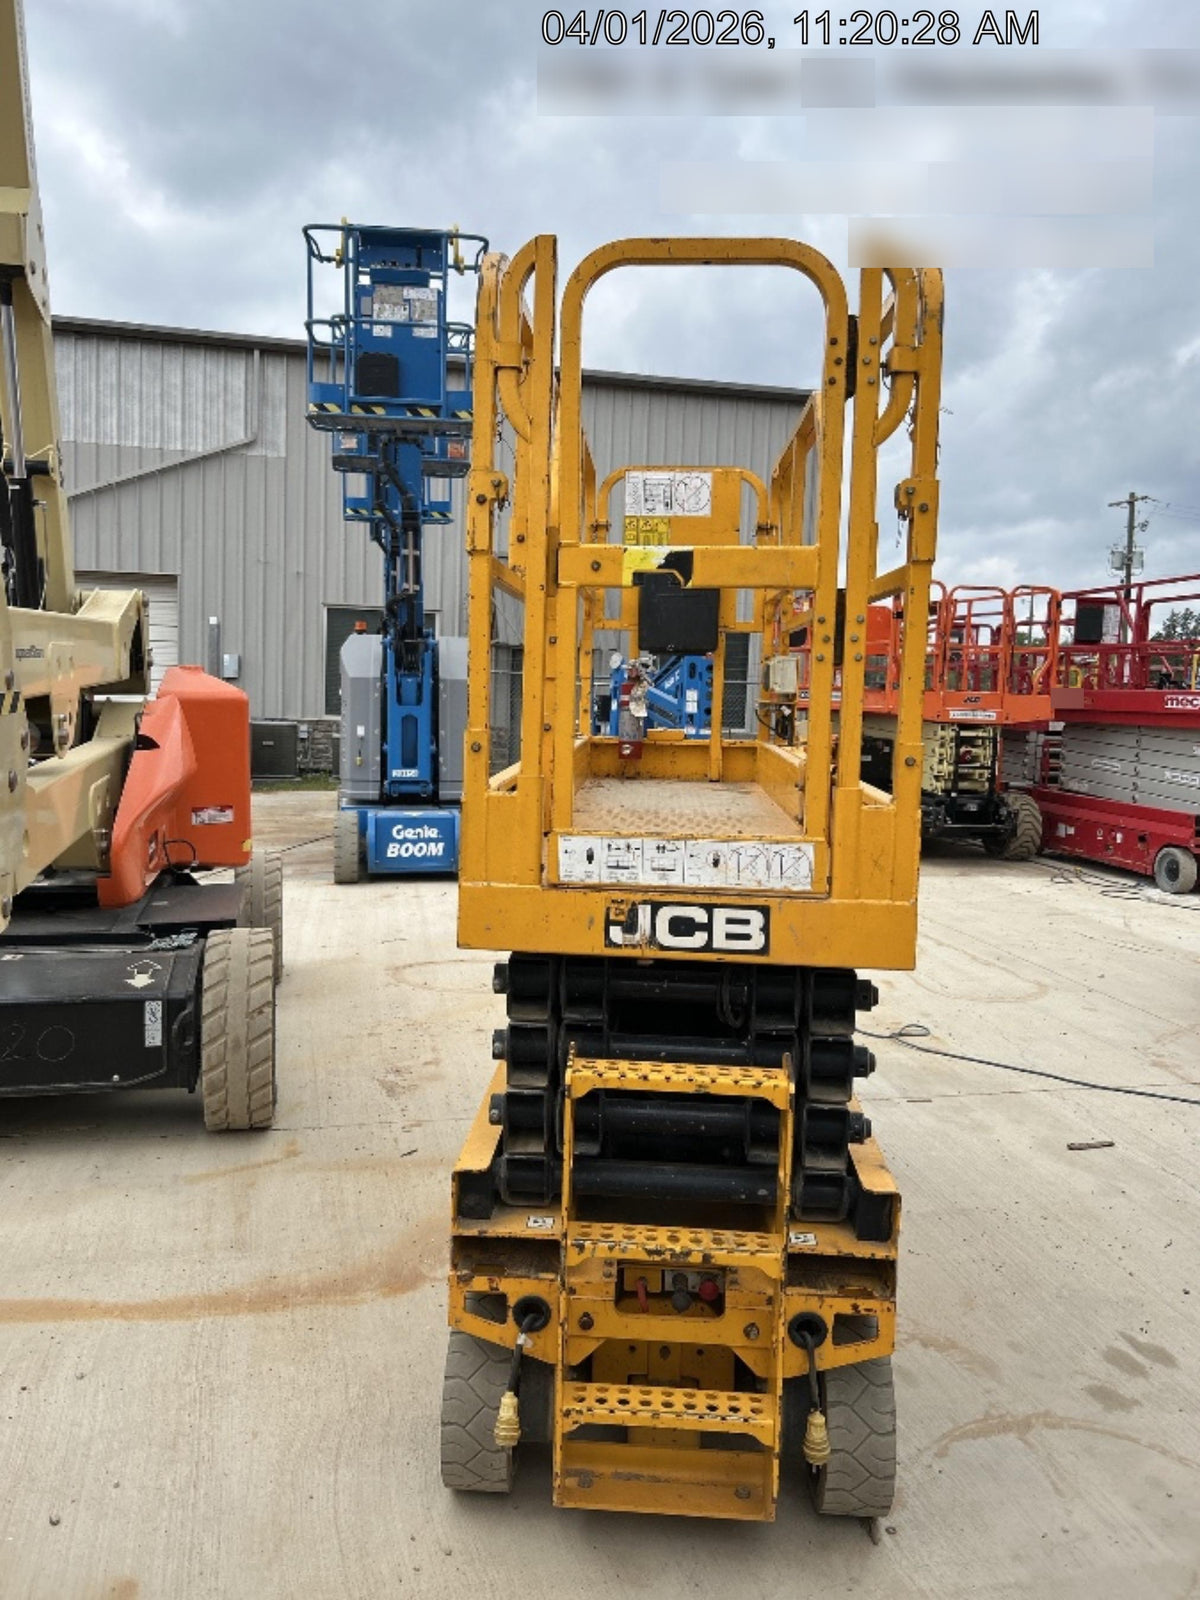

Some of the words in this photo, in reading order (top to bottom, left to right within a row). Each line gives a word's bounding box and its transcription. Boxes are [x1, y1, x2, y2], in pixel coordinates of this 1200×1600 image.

[392, 824, 439, 840] Genie
[386, 842, 445, 858] BOOM
[609, 904, 766, 950] JCB
